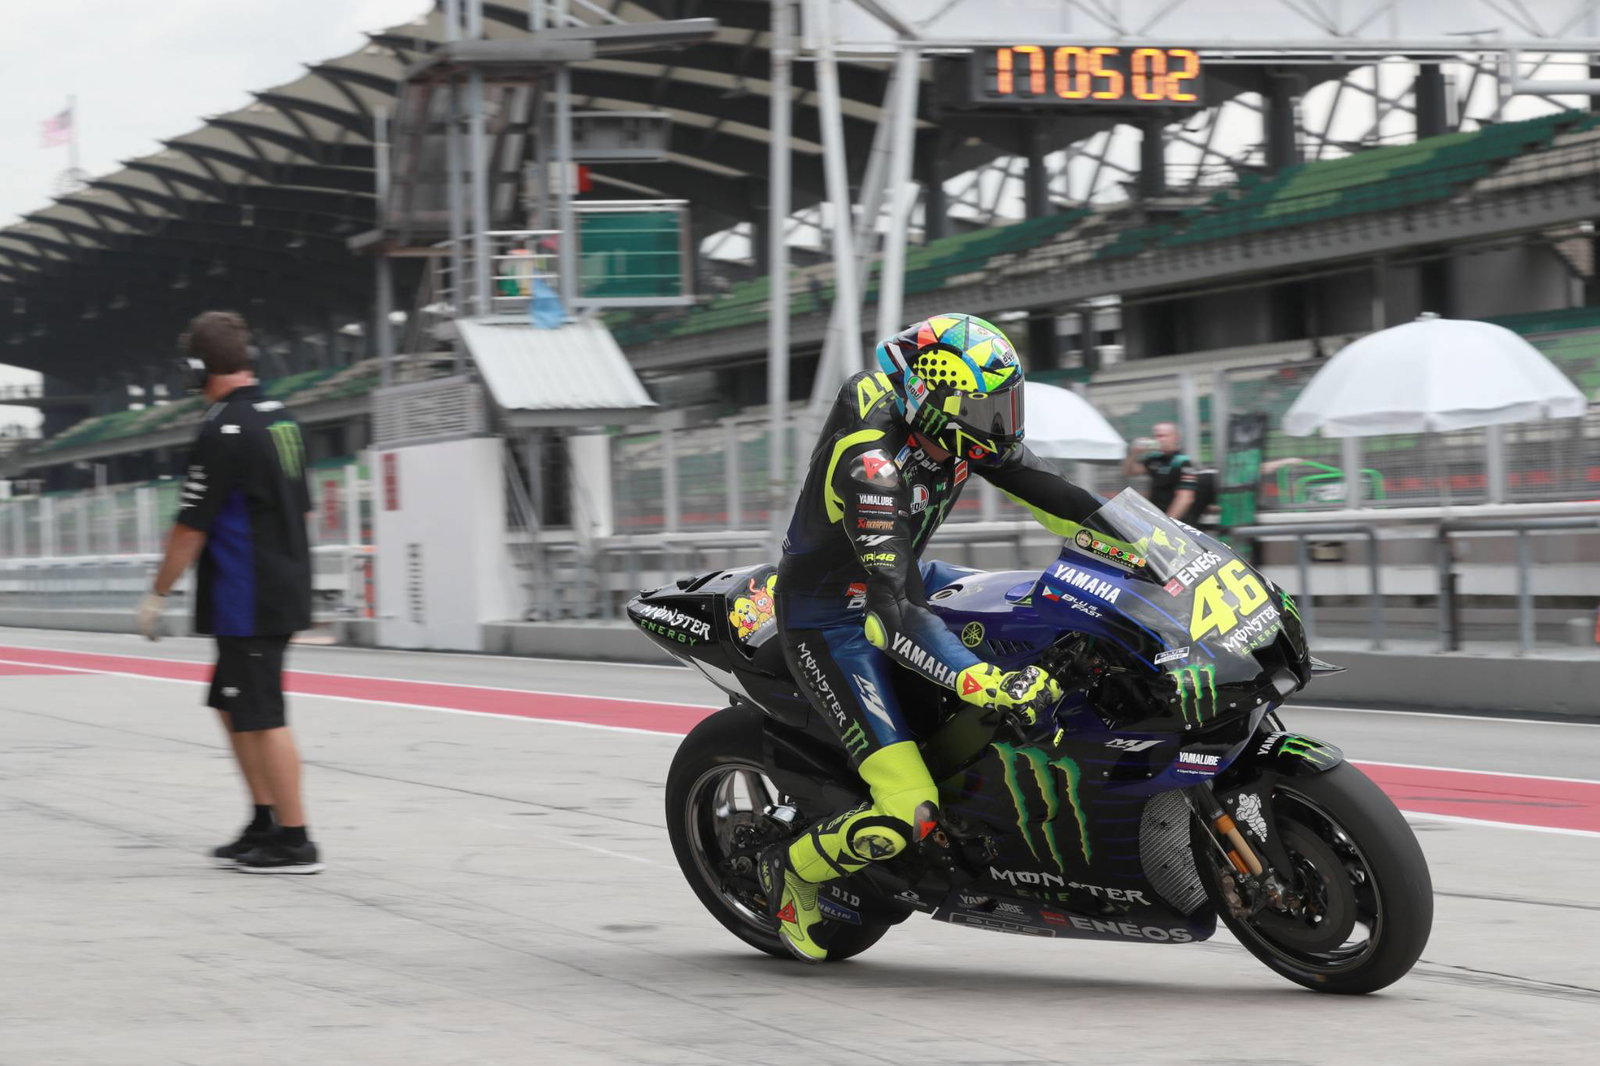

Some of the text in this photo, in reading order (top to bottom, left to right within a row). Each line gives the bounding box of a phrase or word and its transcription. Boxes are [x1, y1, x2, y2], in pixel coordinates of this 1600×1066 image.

[997, 45, 1200, 101] 17 05 02
[859, 494, 894, 506] YAMALUBE
[1053, 564, 1121, 604] YAMAHA
[1176, 550, 1222, 587] ENEOS
[1189, 559, 1269, 642] 46
[640, 618, 697, 647] ENERGY
[1241, 620, 1283, 655] ENERGY
[891, 632, 956, 689] YAMAHA
[1179, 751, 1220, 766] YAMALUBE
[959, 894, 1025, 915] YAMUBE
[1069, 916, 1193, 943] ENEOS
